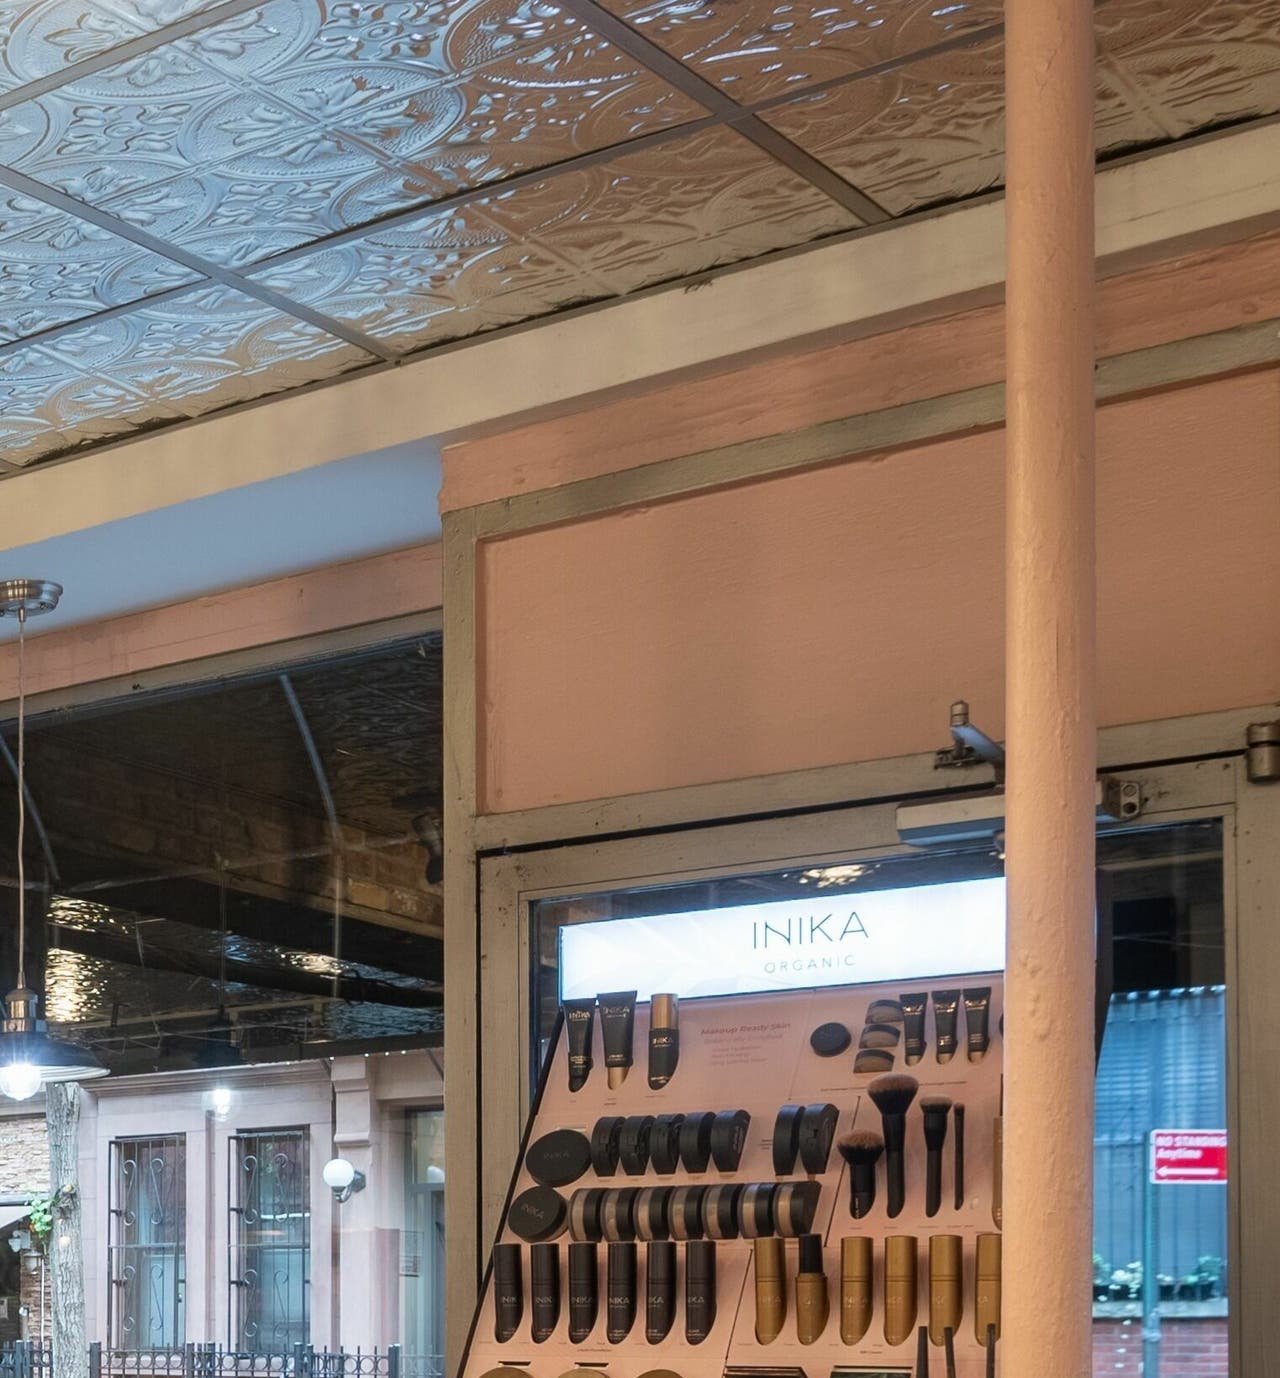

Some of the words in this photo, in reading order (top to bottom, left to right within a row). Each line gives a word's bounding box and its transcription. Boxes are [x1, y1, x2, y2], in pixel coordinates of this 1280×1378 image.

[753, 911, 869, 950] INIKA
[764, 954, 856, 974] ORGANIC
[1156, 1136, 1173, 1147] NO
[1157, 1148, 1203, 1160] Anytime
